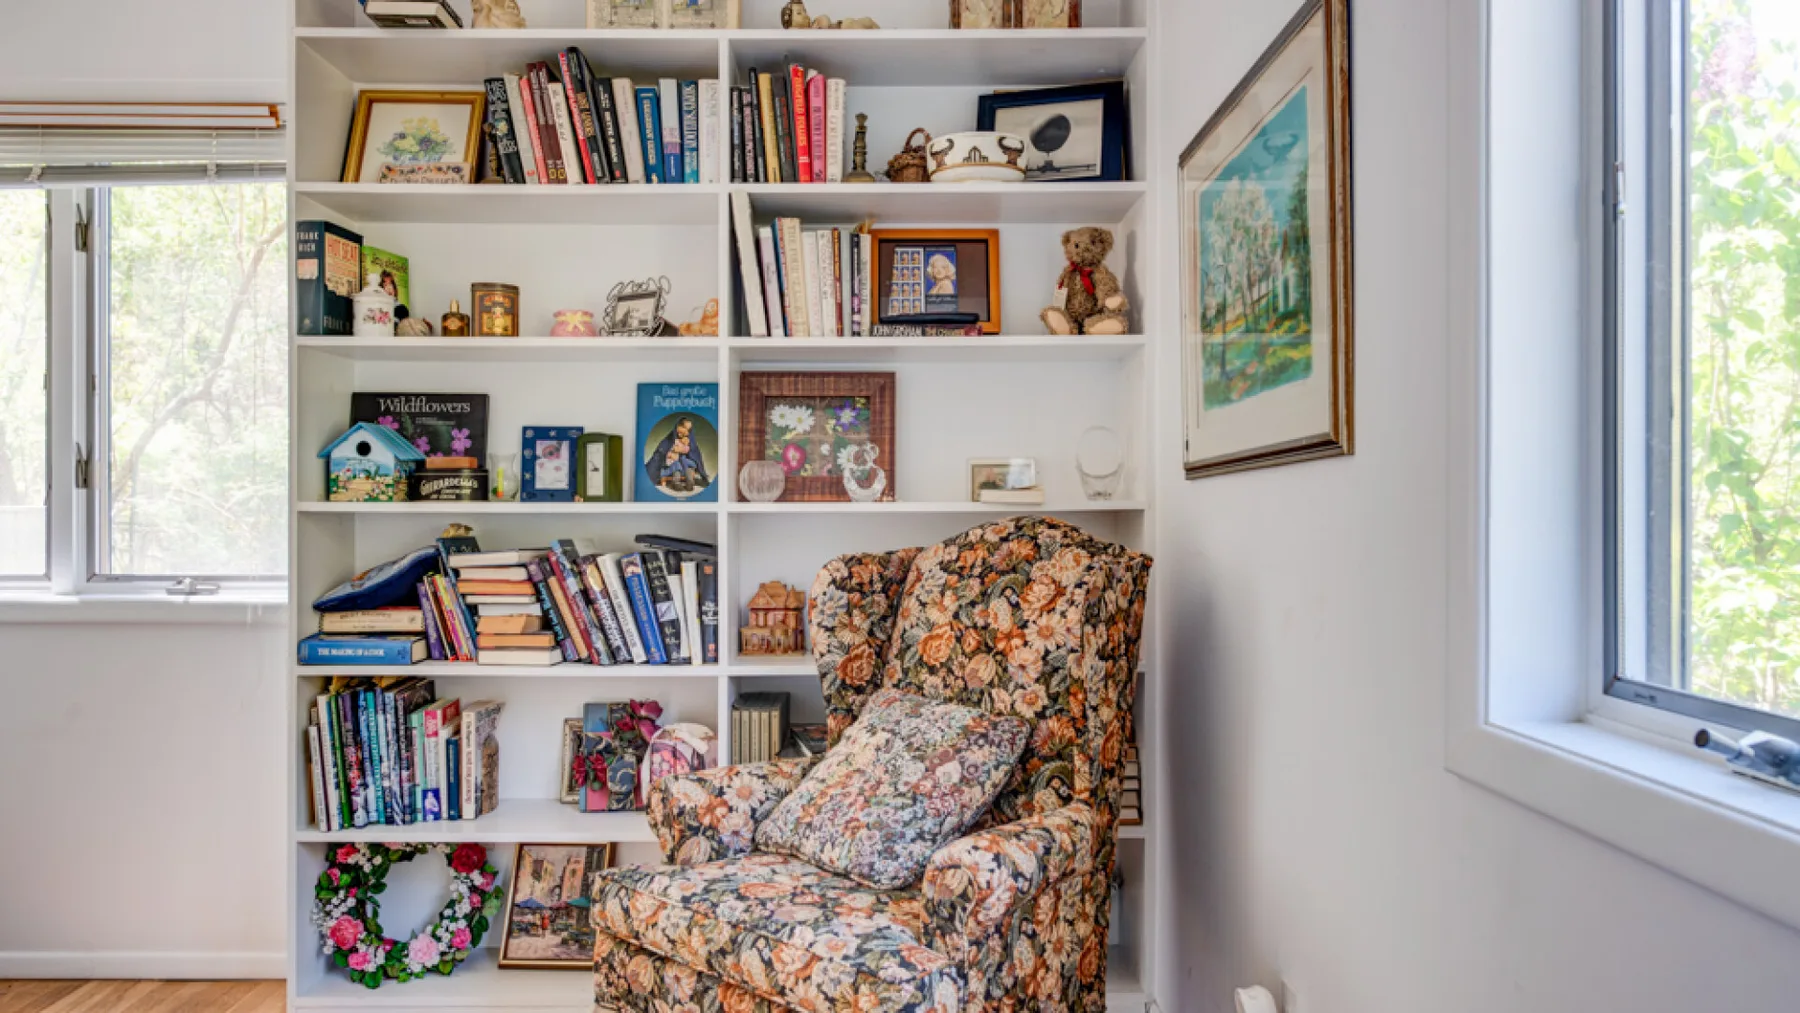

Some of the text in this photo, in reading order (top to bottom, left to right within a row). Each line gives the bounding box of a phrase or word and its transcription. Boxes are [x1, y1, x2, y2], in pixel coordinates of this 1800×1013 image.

[797, 115, 807, 146] FOLLIES
[297, 231, 319, 241] FRANK
[298, 242, 316, 253] RICH
[376, 395, 471, 413] Wildflowers
[653, 395, 715, 410] Puppenbuch
[317, 647, 329, 656] THE
[330, 647, 354, 656] MAKING
